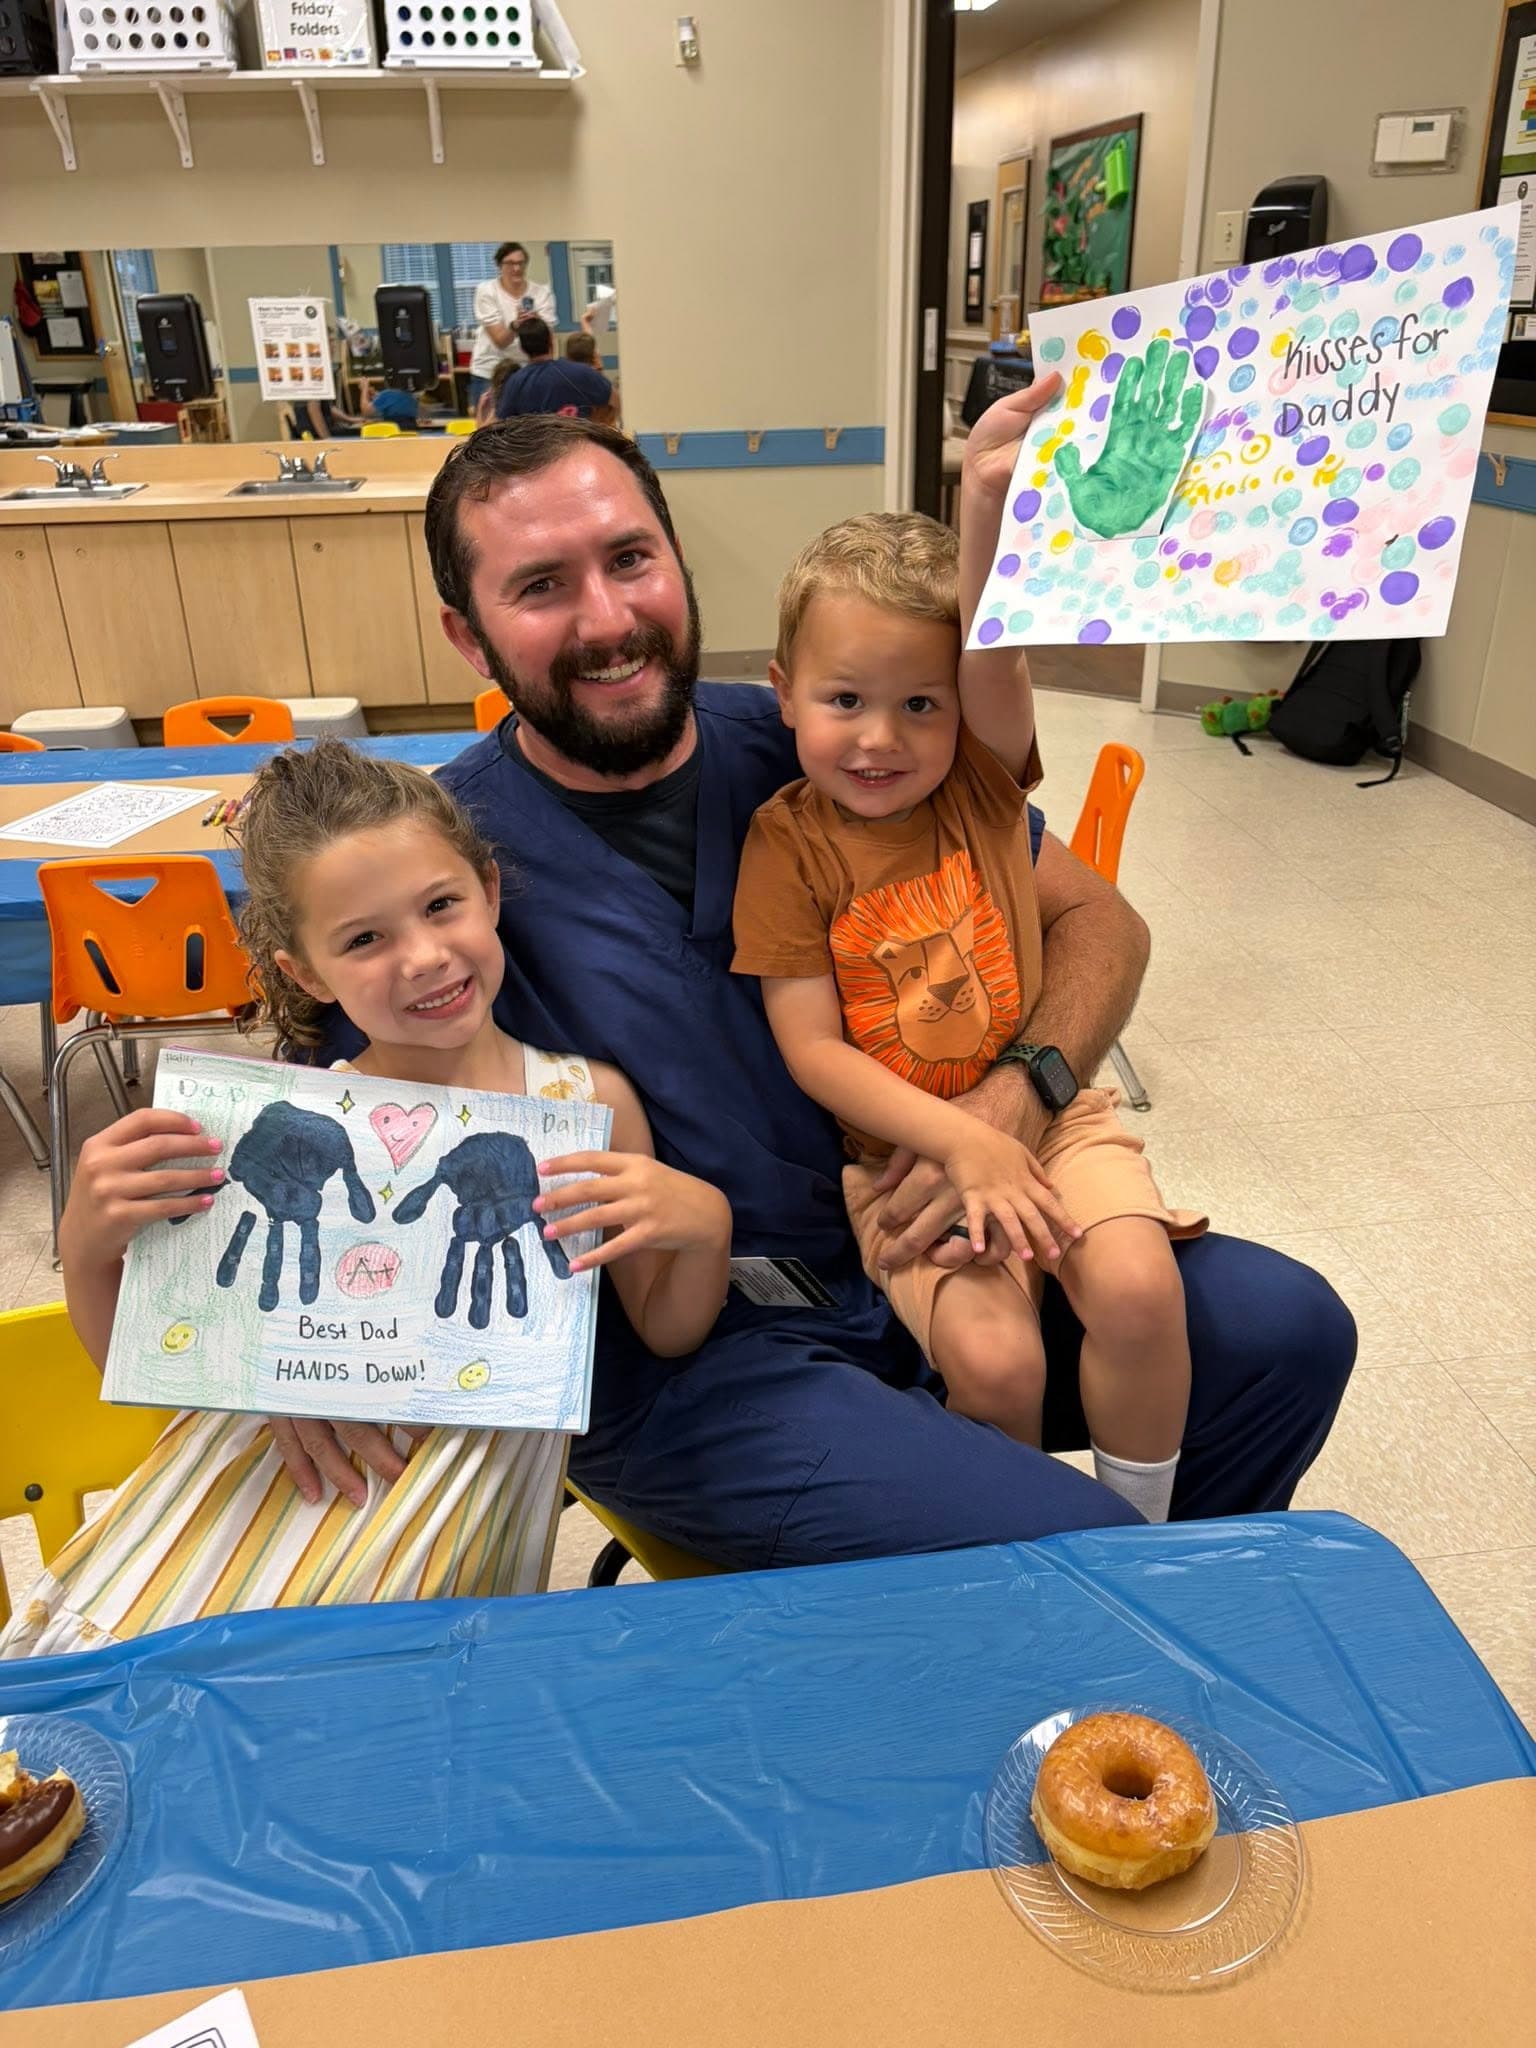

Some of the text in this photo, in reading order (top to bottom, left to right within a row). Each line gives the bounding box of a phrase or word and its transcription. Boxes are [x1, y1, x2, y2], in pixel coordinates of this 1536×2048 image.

[291, 2, 334, 18] Friday
[290, 22, 340, 36] Folders
[1283, 313, 1449, 380] Kisses for
[1281, 371, 1401, 437] Daddy
[346, 1257, 395, 1287] A+
[299, 1314, 398, 1341] Best Dad
[275, 1358, 350, 1382] HANDS
